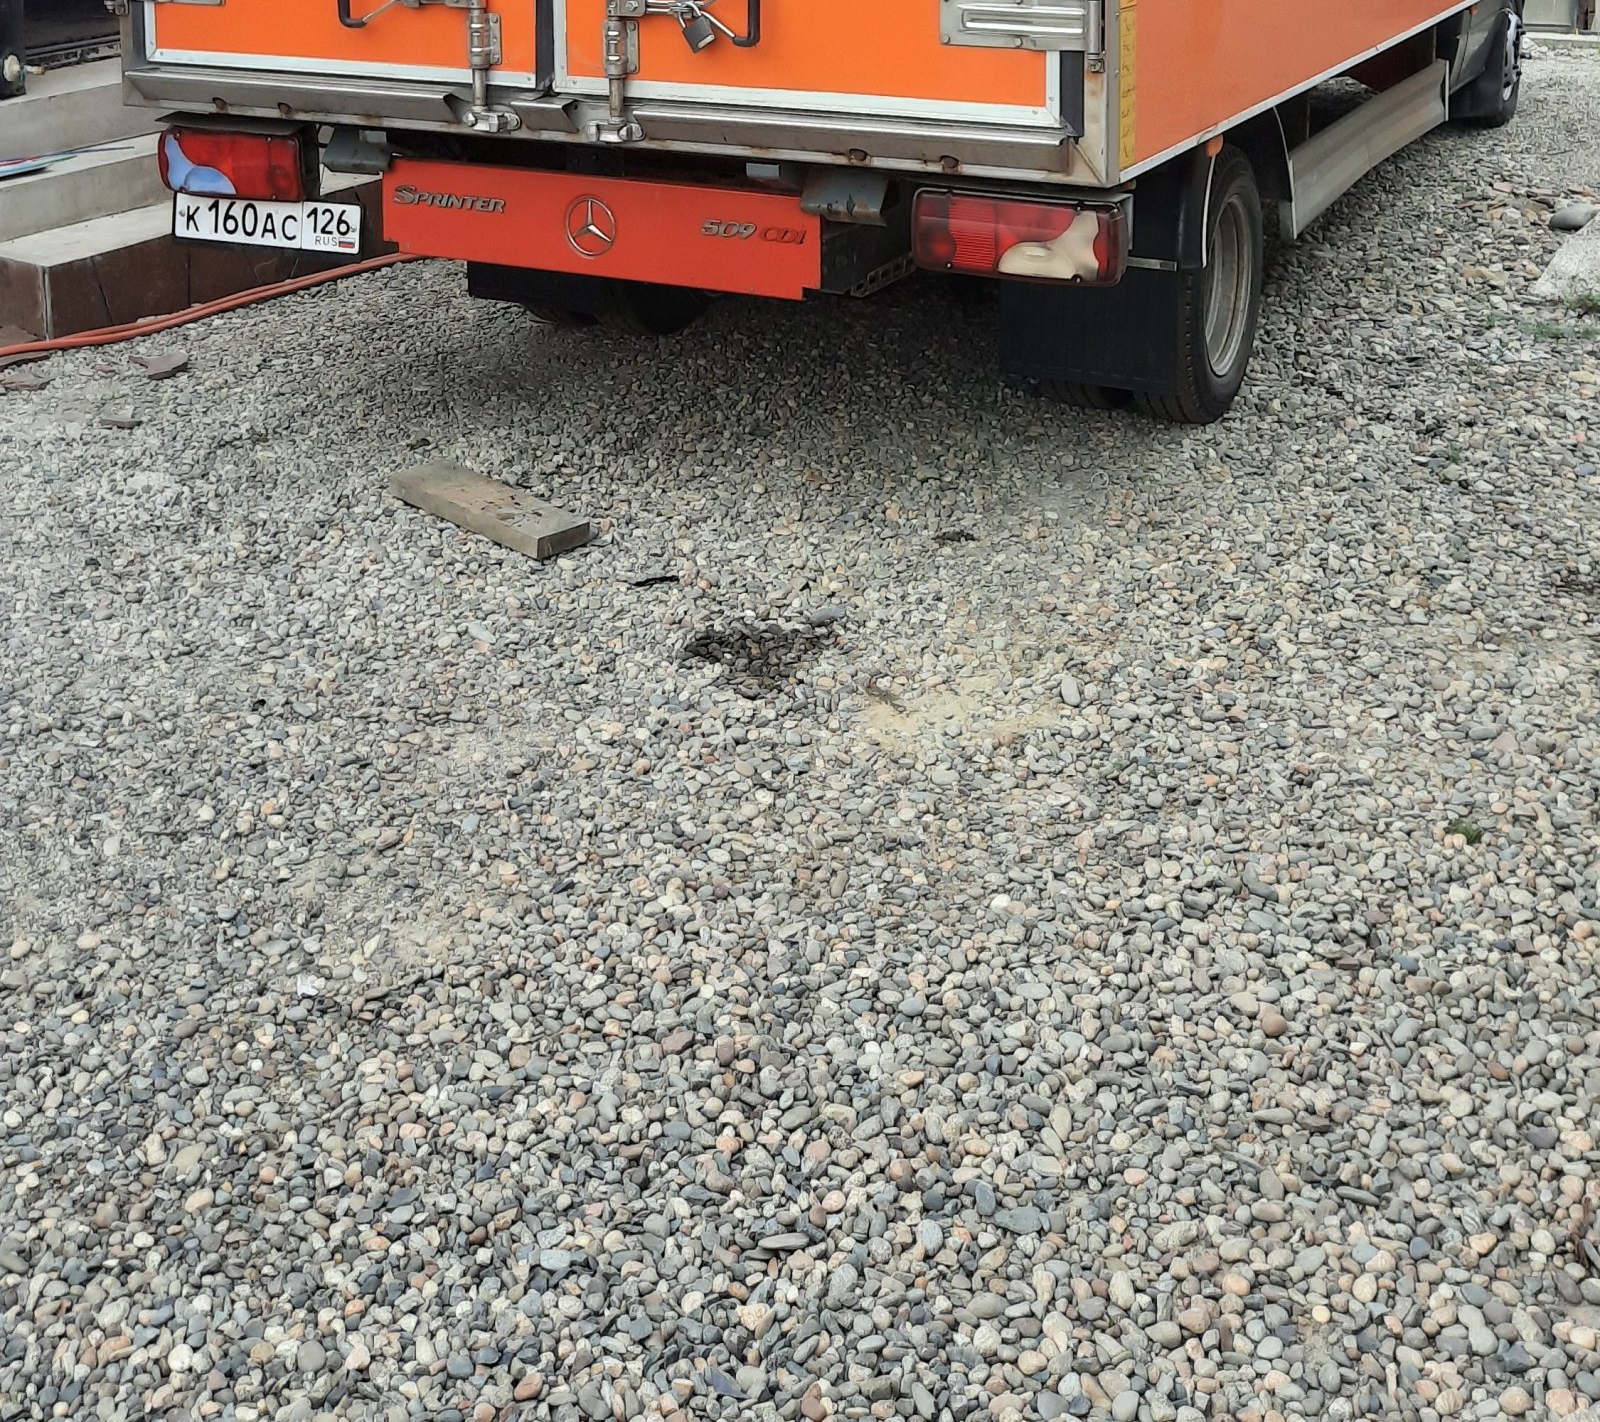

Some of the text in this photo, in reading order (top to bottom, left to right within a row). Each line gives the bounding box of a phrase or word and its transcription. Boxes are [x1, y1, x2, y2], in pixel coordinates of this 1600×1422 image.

[306, 206, 351, 237] 126
[701, 218, 807, 245] 509 CDI
[315, 235, 337, 247] RUS
